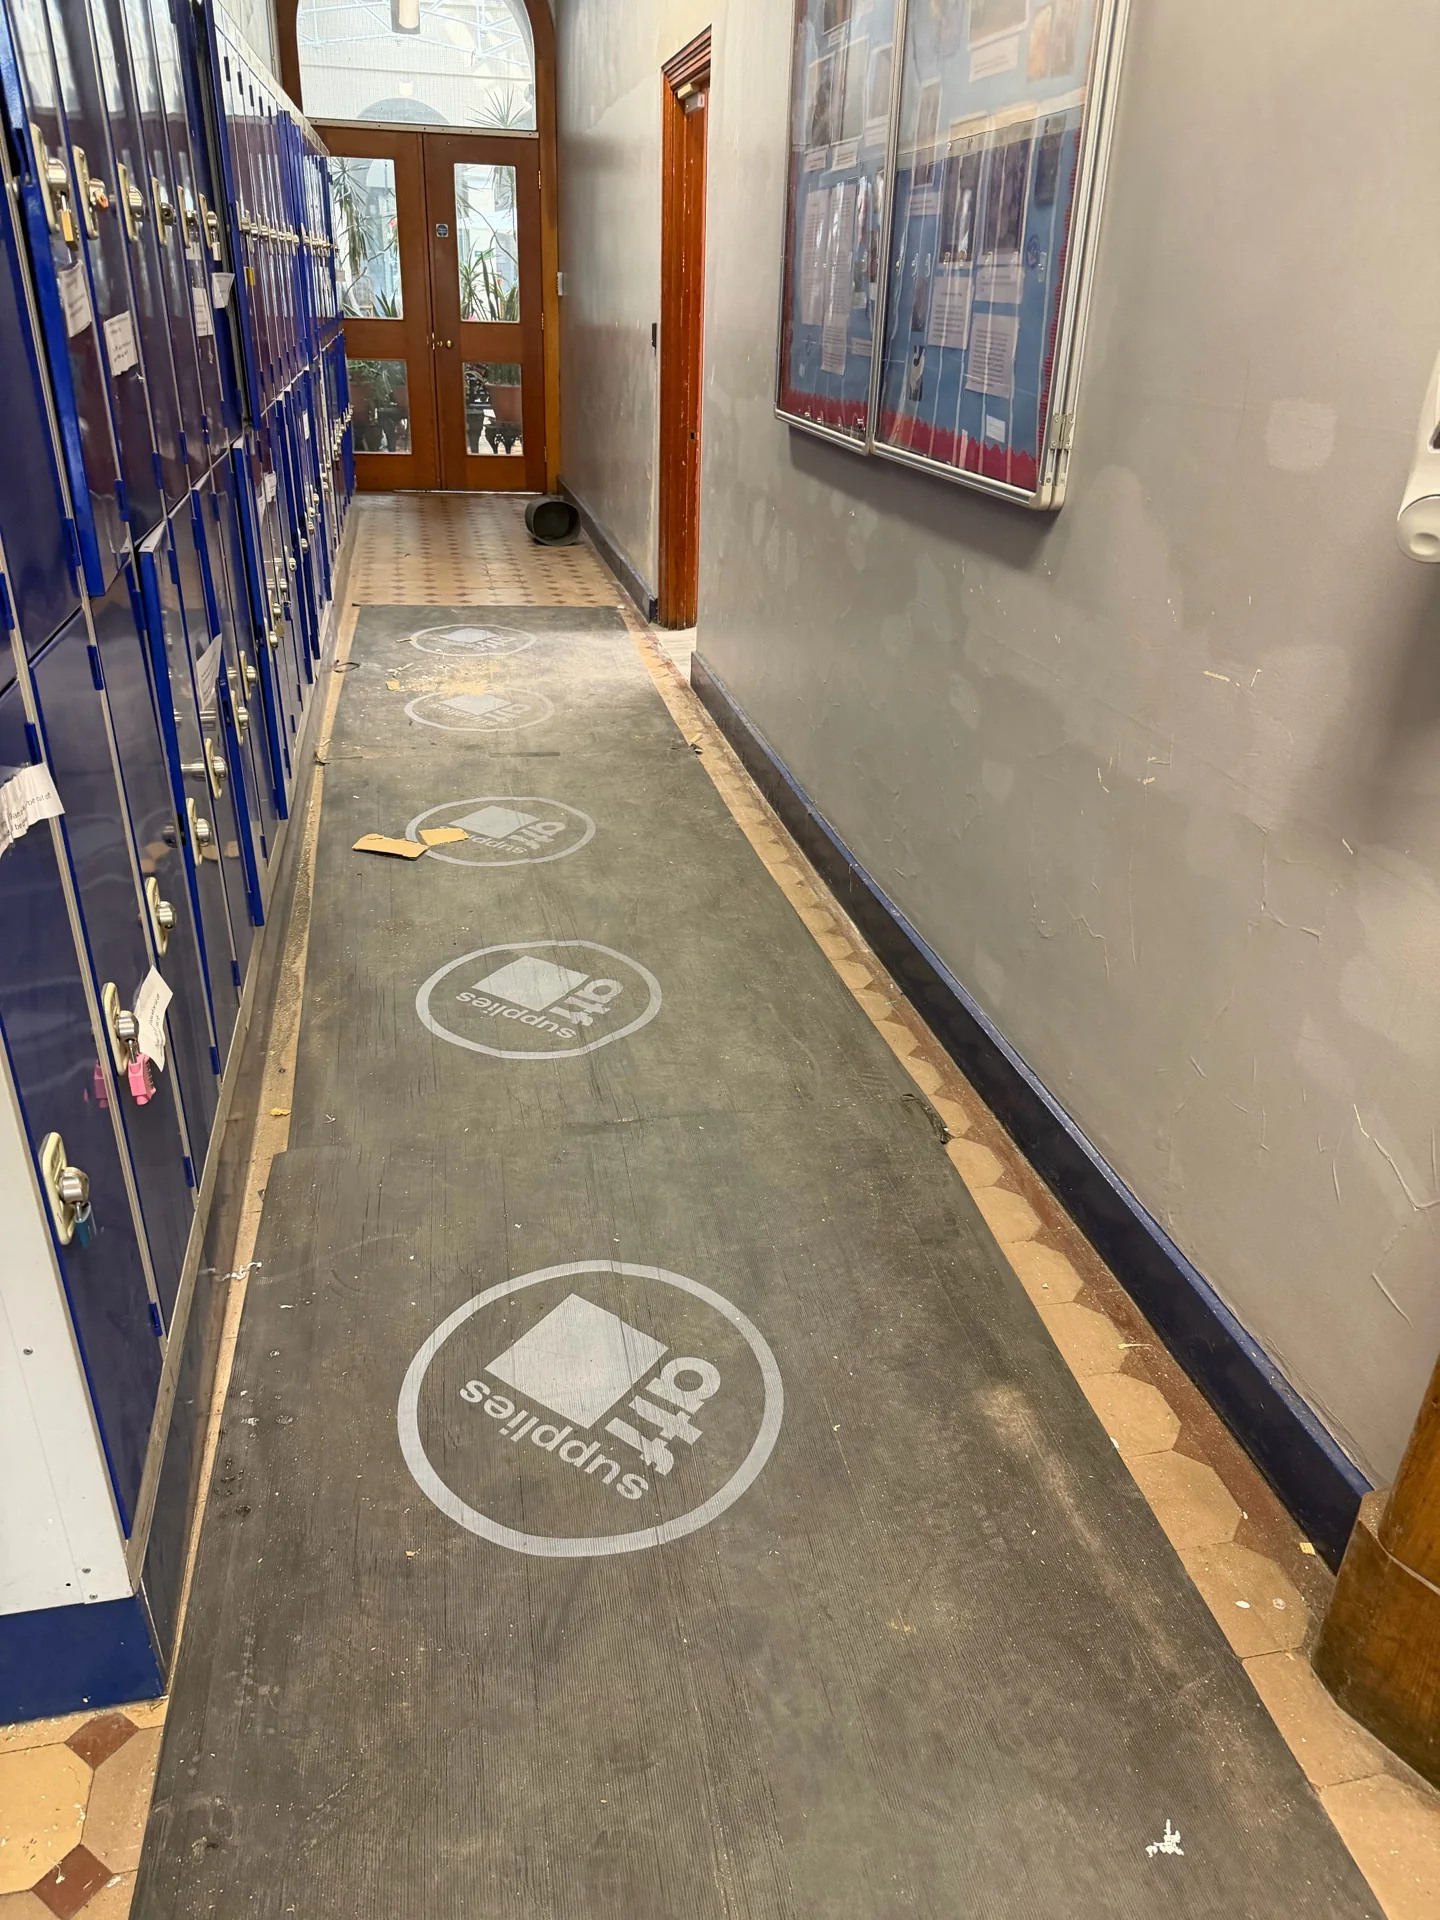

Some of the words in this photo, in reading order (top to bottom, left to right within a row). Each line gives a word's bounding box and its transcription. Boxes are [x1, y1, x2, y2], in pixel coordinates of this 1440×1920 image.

[483, 704, 531, 723] art
[507, 821, 566, 850] art
[455, 991, 577, 1039] supplies
[549, 978, 624, 1027] art
[459, 1379, 650, 1500] supplies
[604, 1356, 721, 1477] art
